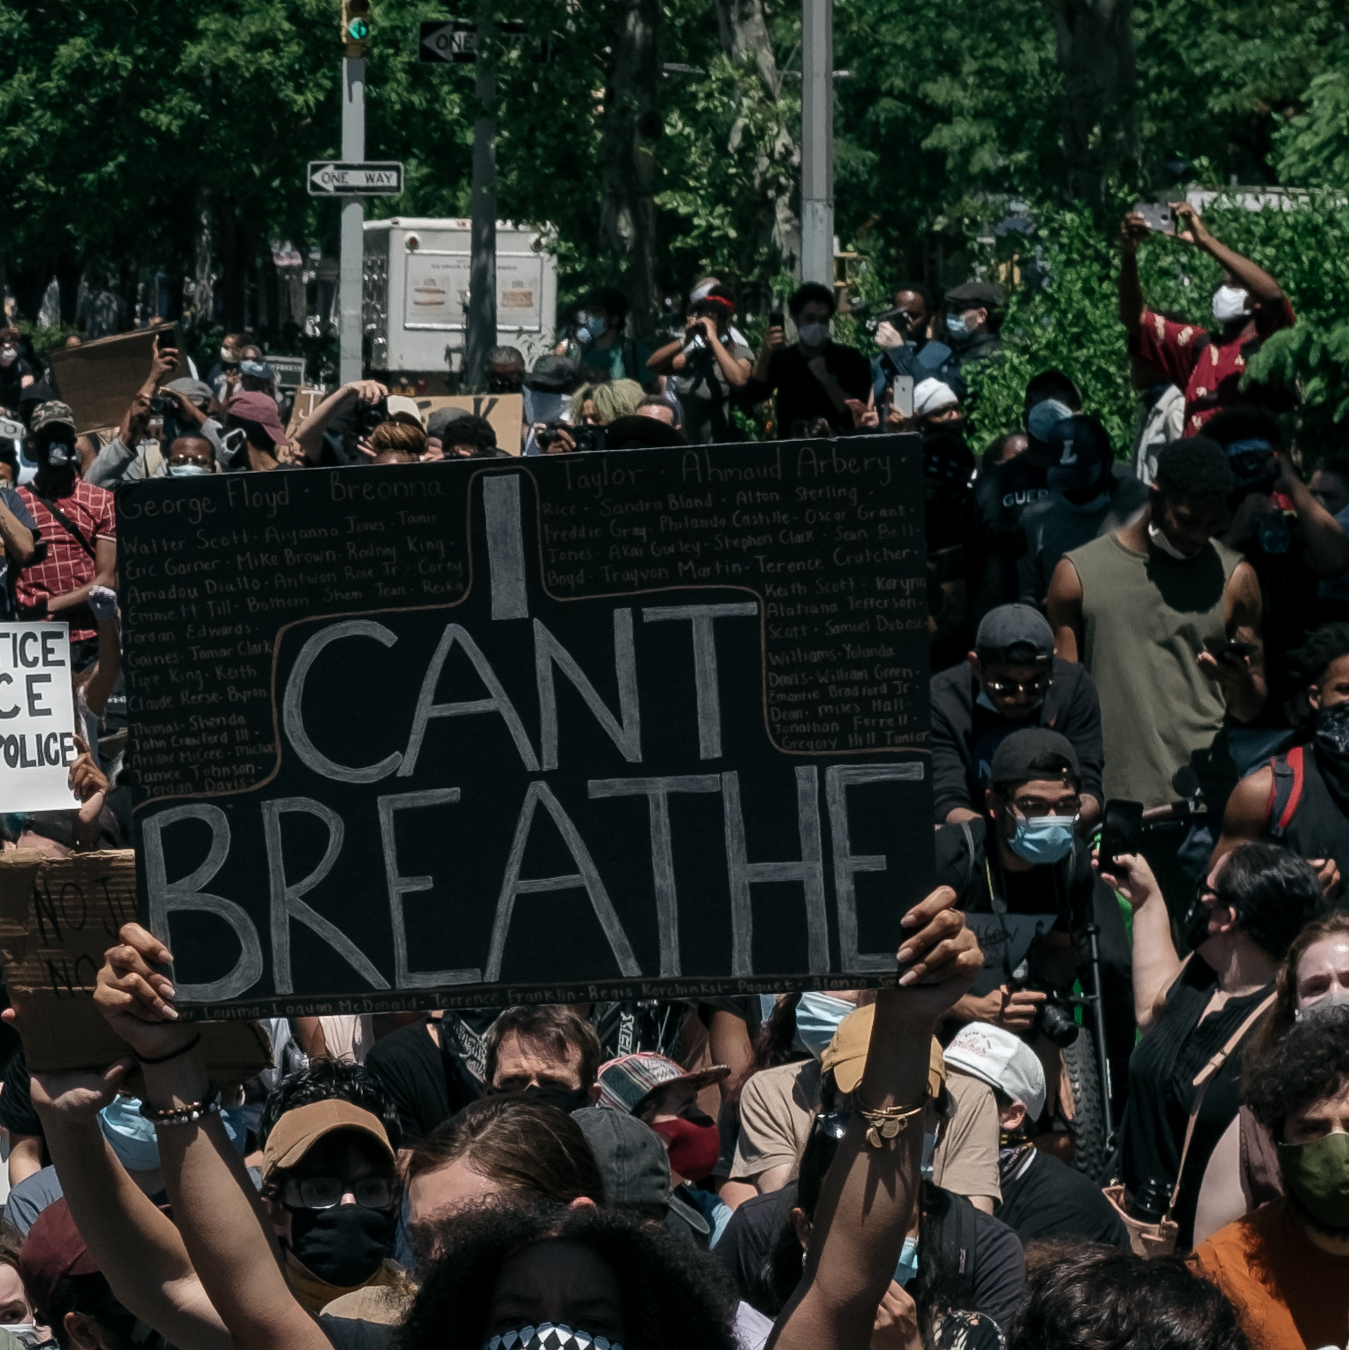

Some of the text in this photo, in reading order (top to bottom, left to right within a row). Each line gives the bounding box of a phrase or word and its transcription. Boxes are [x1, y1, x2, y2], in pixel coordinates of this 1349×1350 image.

[321, 174, 395, 185] ONE WAY
[1059, 440, 1078, 464] L
[117, 445, 892, 524] George Floyd Breonna Taylor Ahmaud Arbery
[121, 535, 186, 556] Walter
[195, 527, 249, 550] Scott
[395, 509, 438, 527] Tamir
[542, 501, 578, 517] Rice
[599, 498, 663, 518] Sandra
[668, 492, 713, 510] Bland
[735, 490, 780, 506] Alton
[125, 560, 156, 580] Eric
[165, 557, 221, 577] Garner
[283, 547, 337, 566] Brown
[407, 534, 446, 558] King
[609, 518, 649, 543] Gray
[857, 503, 906, 521] Grant
[127, 574, 261, 604] Amadou Diallo
[207, 545, 910, 618] Till Boyd Trayvon Martin Terence Crutcher
[123, 622, 252, 645] Jordan Edwards
[127, 650, 181, 668] Gaines
[168, 664, 258, 692] King Keith
[282, 602, 759, 782] CANT
[871, 698, 905, 713] Hall
[142, 761, 924, 1002] BREATHE
[33, 877, 88, 953] NO
